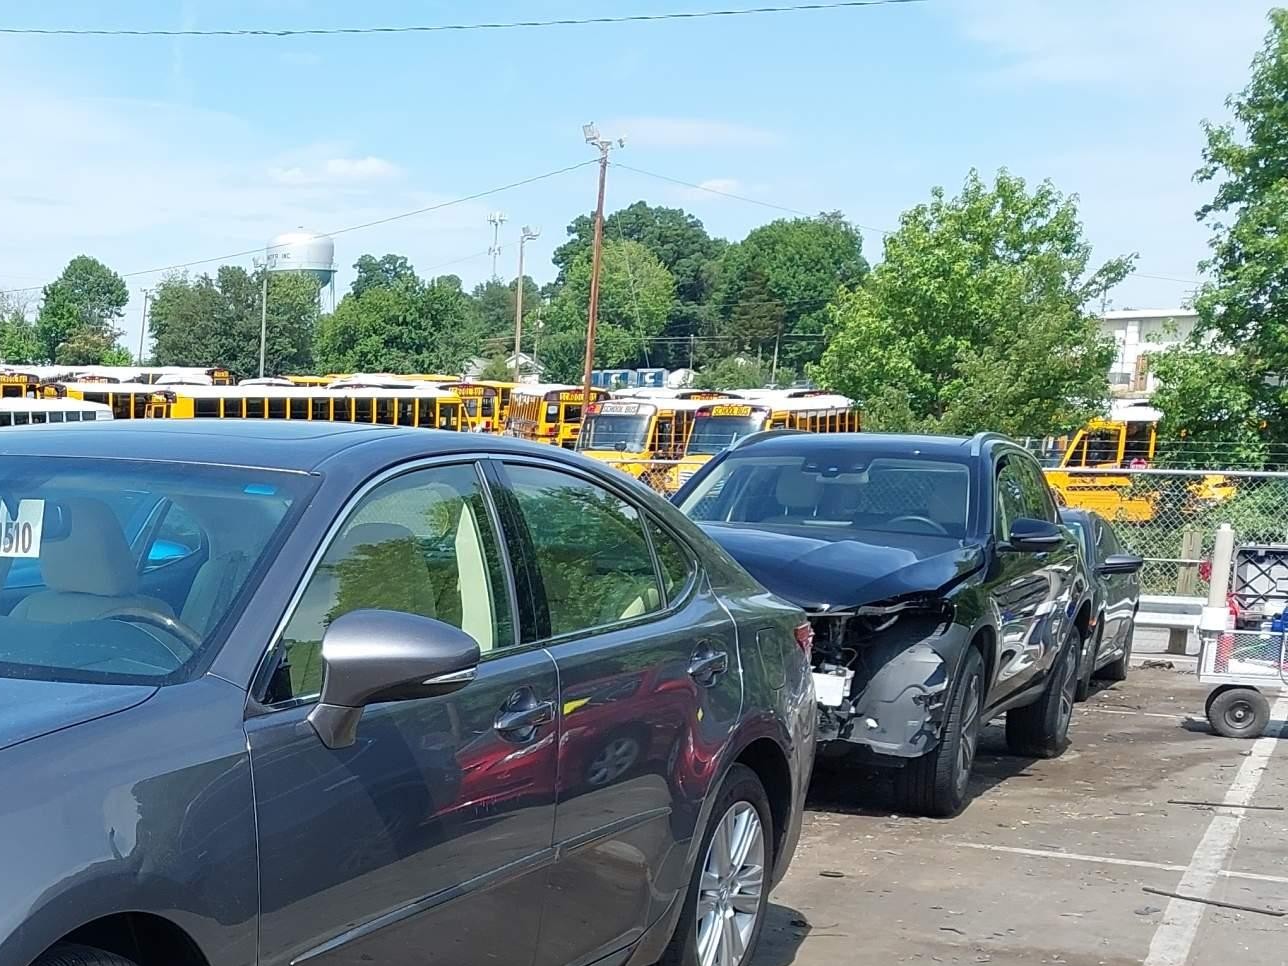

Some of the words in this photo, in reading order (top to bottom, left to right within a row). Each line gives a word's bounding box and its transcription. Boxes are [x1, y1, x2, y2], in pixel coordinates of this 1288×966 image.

[603, 404, 623, 414] SCHOOL
[624, 404, 637, 414] BUS
[713, 406, 735, 416] SCHOOL
[736, 406, 750, 416] BUS
